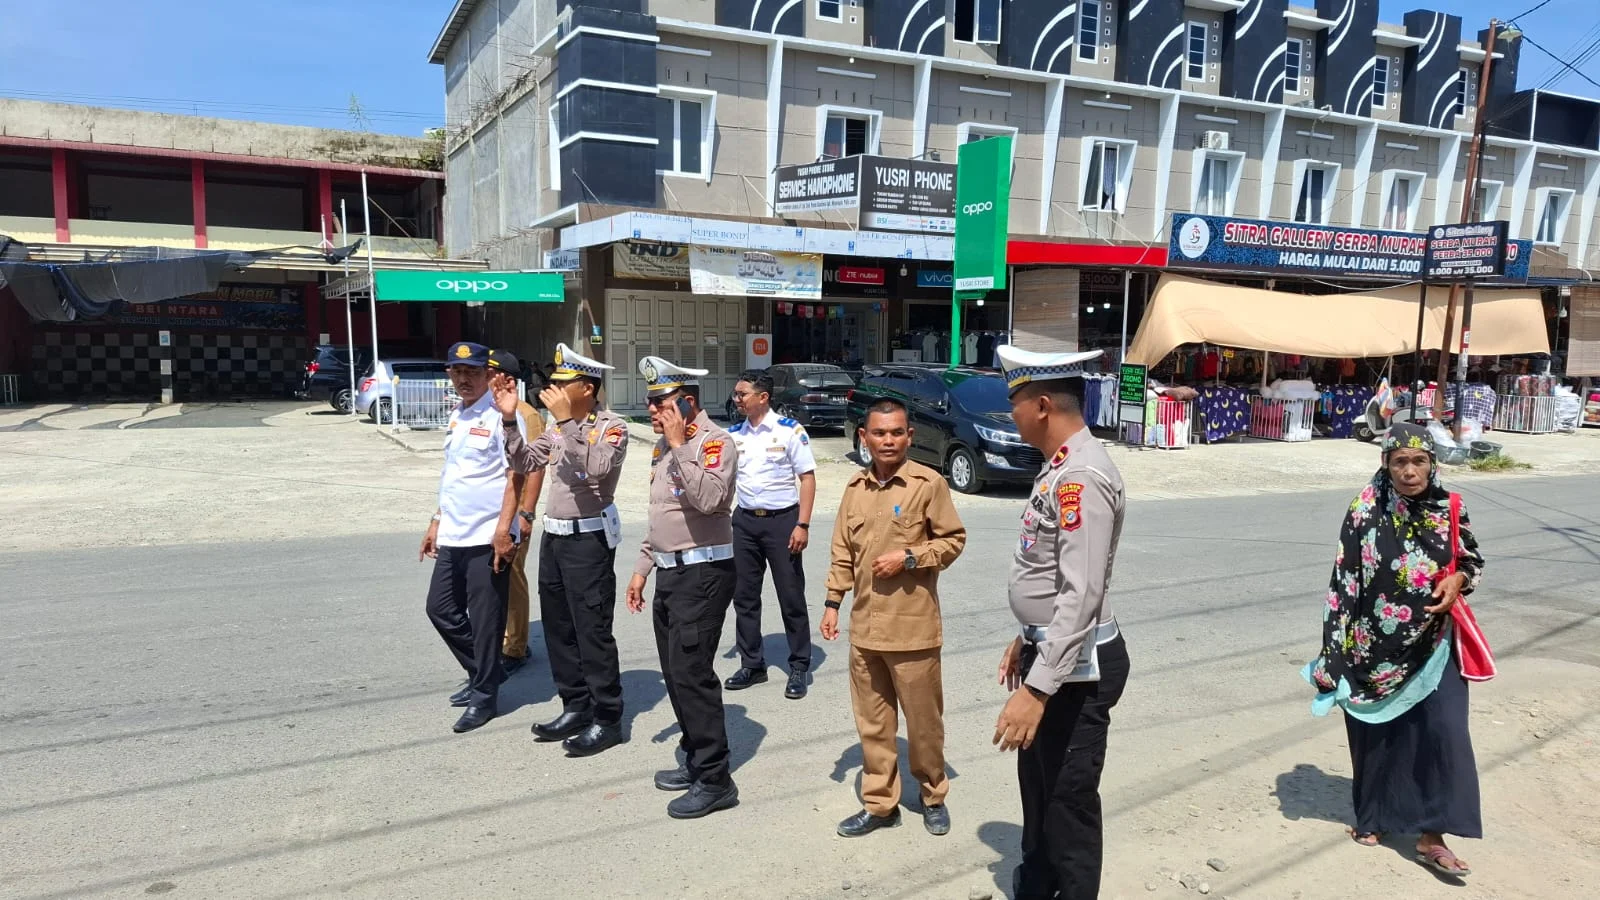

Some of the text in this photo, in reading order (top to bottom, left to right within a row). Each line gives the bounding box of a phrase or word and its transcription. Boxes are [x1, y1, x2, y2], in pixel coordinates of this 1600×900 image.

[779, 172, 855, 199] SERVICE HANDPHONE
[875, 166, 953, 191] YUSRI PHONE
[962, 201, 993, 216] oppo
[692, 229, 719, 238] SUPER
[1223, 222, 1427, 256] SITRA GALLERY SERBA MURAH
[1430, 235, 1497, 249] SERBA MURAH
[1433, 247, 1493, 260] SERBA 35.000
[1279, 251, 1420, 273] HARGA MULAI DARI 5.000
[846, 270, 857, 279] ZTE
[924, 271, 953, 283] vivo
[1429, 267, 1452, 275] 5.000
[1464, 265, 1494, 275] 35.000
[436, 279, 508, 293] oppo
